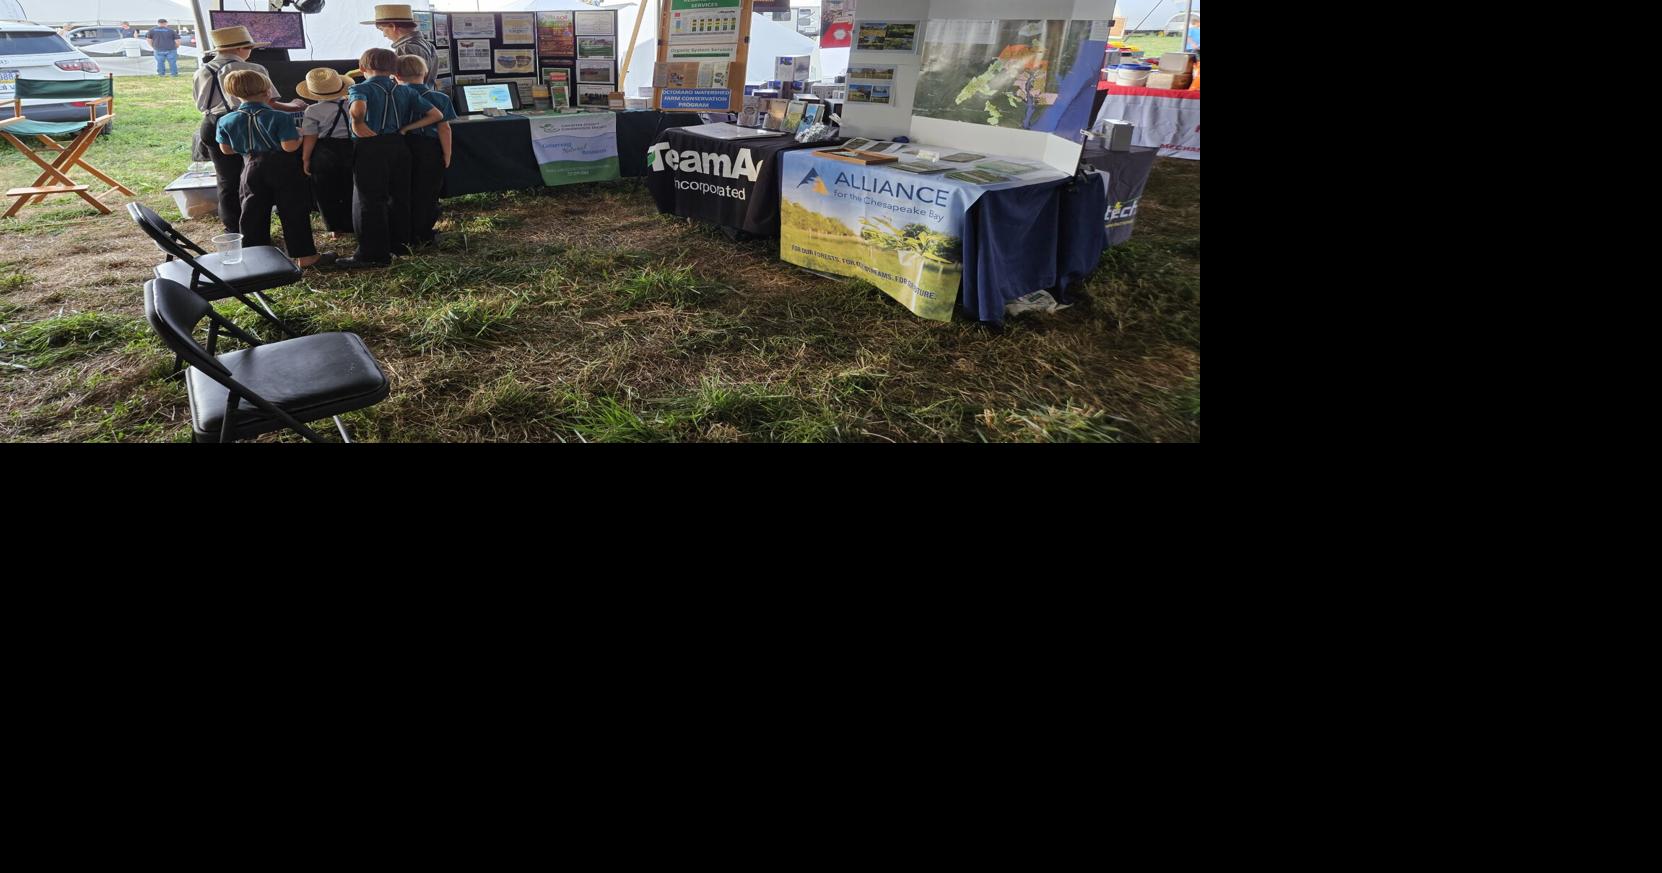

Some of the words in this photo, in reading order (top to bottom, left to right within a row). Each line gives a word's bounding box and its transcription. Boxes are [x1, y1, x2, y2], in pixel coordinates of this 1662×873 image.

[647, 142, 764, 182] TeamA
[674, 180, 746, 201] ncorporated
[833, 189, 848, 199] for
[849, 193, 862, 202] the
[863, 196, 927, 216] Chesapeake
[928, 209, 945, 223] Bay
[834, 171, 950, 208] ALLIANCE
